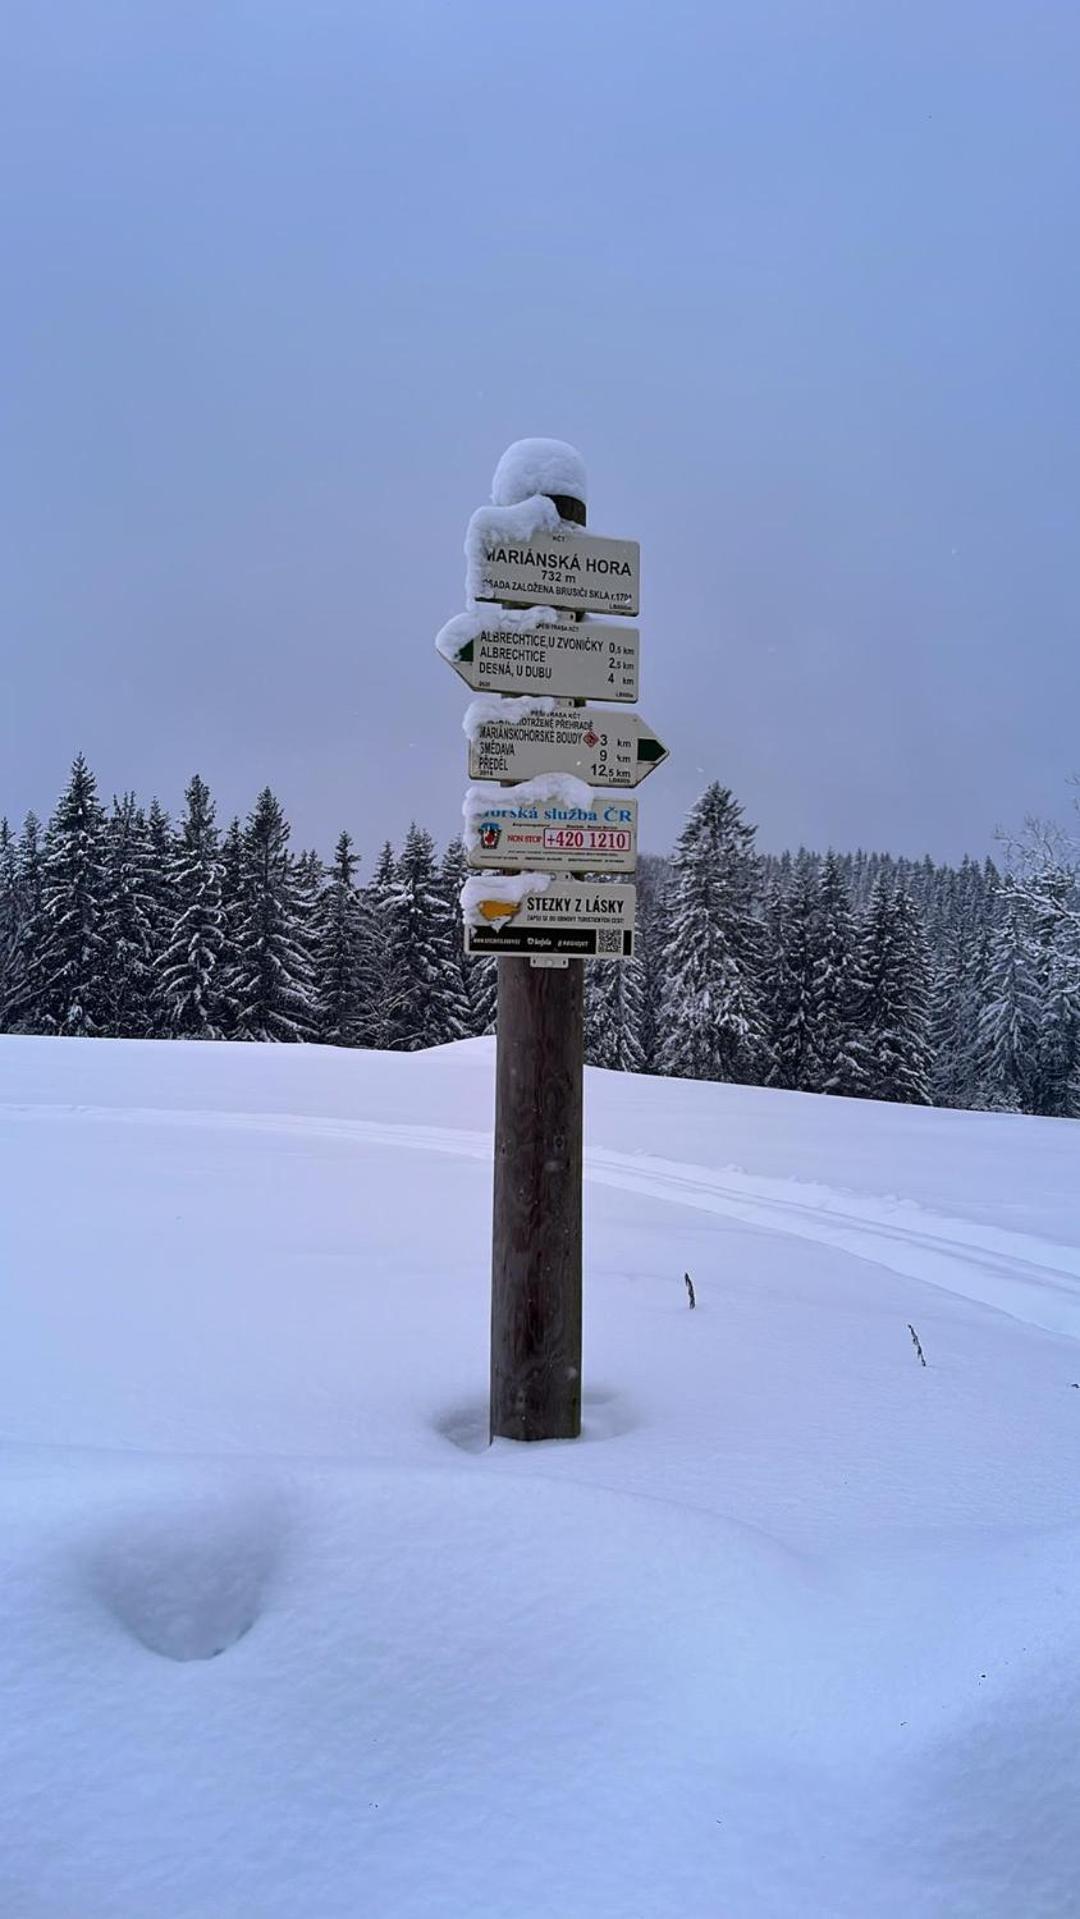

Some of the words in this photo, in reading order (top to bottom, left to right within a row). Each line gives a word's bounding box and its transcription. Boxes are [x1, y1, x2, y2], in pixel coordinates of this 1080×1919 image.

[586, 558, 632, 576] HORA
[541, 570, 562, 582] 732
[565, 575, 576, 583] m
[512, 581, 554, 594] ZALOŽENA
[589, 590, 610, 600] SKLA
[557, 636, 604, 652] ZVONIČKY
[609, 642, 622, 654] 0,5
[623, 647, 634, 655] km
[480, 646, 546, 662] ALBRECHTICE
[609, 657, 622, 670] 2,5
[622, 661, 634, 670] km
[480, 661, 514, 678] DESNÁ,
[516, 664, 523, 676] U
[526, 666, 552, 679] DUBU
[608, 673, 614, 684] 4
[622, 677, 634, 685] km
[556, 732, 582, 744] BOUDY
[600, 734, 608, 746] 3
[618, 738, 631, 747] km
[600, 750, 608, 762] 9
[616, 754, 631, 762] km
[591, 764, 614, 778] 12,5
[616, 769, 631, 778] km
[544, 808, 597, 820] služba
[604, 805, 632, 822] ČR
[508, 834, 524, 842] NON
[525, 835, 542, 844] STOP
[547, 831, 584, 848] +420
[590, 832, 626, 848] 1210
[527, 897, 572, 912] STEZKY
[575, 899, 582, 912] Z
[586, 894, 624, 913] LÁSKY
